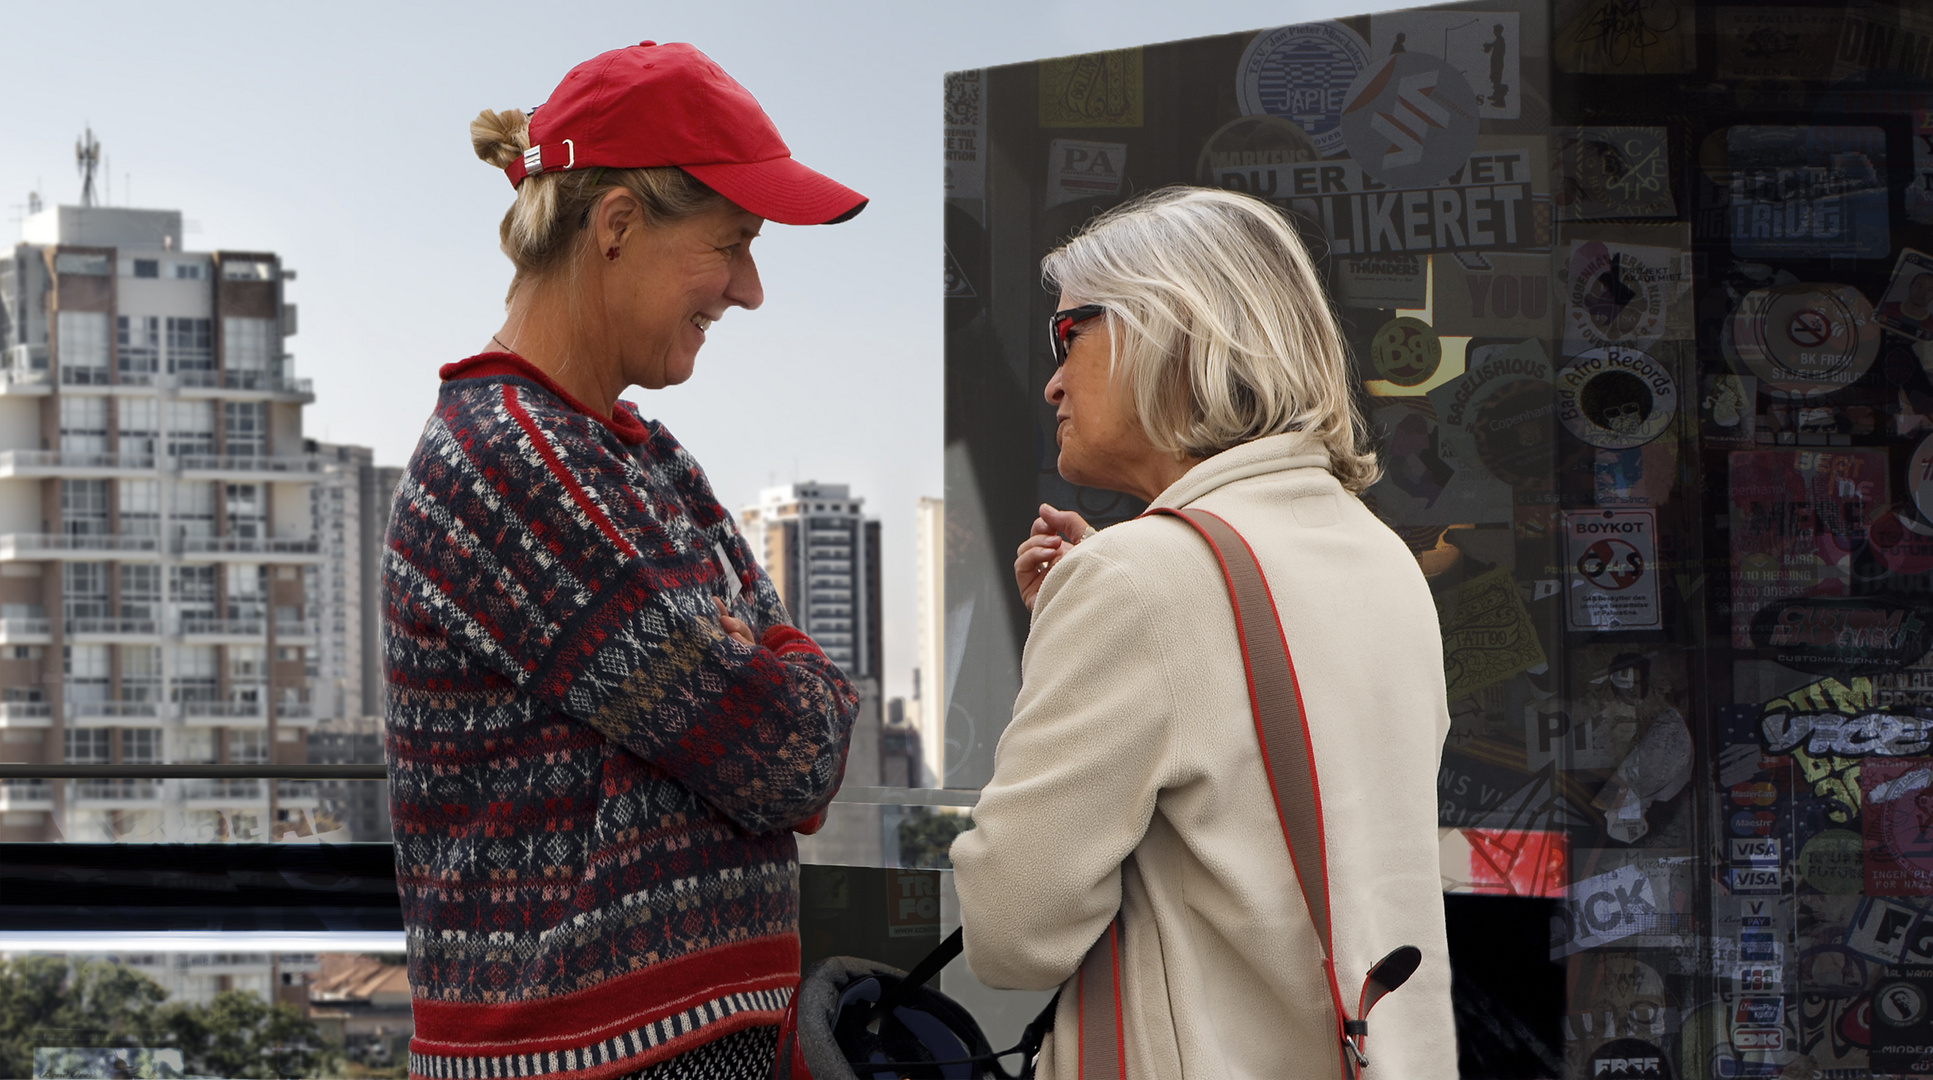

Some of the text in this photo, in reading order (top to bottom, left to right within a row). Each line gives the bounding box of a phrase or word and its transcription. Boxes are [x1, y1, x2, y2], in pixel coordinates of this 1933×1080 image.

[1288, 25, 1321, 37] Pieter
[1278, 88, 1341, 114] JAPIE
[958, 137, 977, 151] TIL
[1061, 149, 1118, 173] PA
[1221, 171, 1278, 197] DU
[1294, 166, 1346, 193] ER
[1349, 262, 1420, 275] THUNDERS
[1465, 274, 1548, 320] YOU
[1800, 352, 1853, 367] BK FREM
[1558, 351, 1671, 421] Bad Afro Records
[1576, 522, 1644, 534] BOYKOT
[1762, 570, 1811, 581] HERNING
[1455, 629, 1507, 647] TATTOO
[1731, 790, 1776, 799] MasterCard
[1736, 842, 1777, 856] VISA
[1737, 872, 1778, 885] VISA
[1871, 870, 1908, 880] INGEN
[1875, 880, 1897, 889] FOR
[1749, 901, 1764, 915] V
[1747, 917, 1766, 926] PAY
